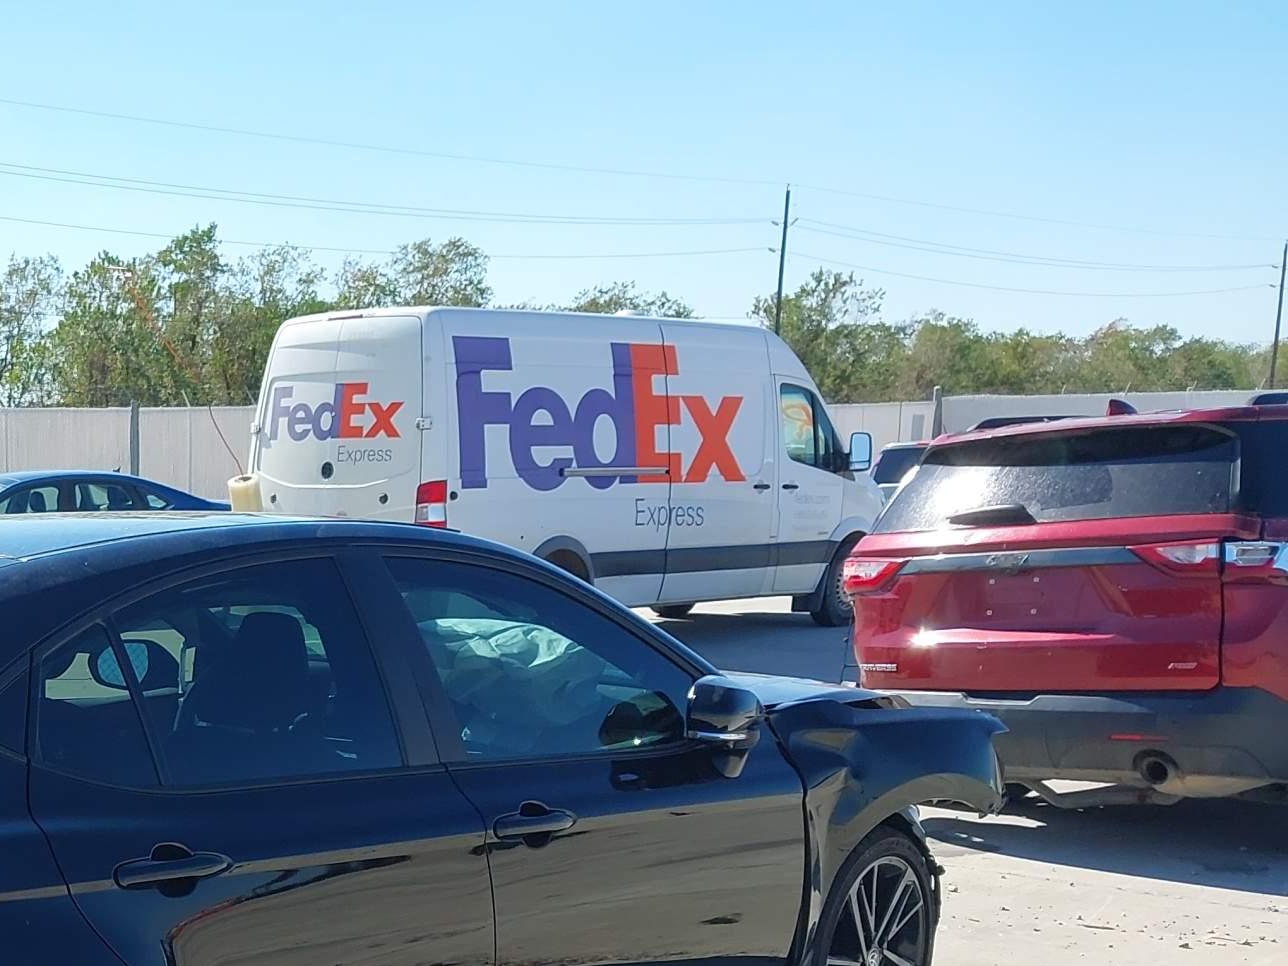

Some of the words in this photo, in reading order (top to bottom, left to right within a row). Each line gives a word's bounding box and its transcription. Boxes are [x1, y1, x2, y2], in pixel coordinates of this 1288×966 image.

[269, 382, 405, 442] FedEx
[452, 335, 747, 491] FedEx
[336, 445, 392, 465] Express
[634, 498, 705, 532] Express
